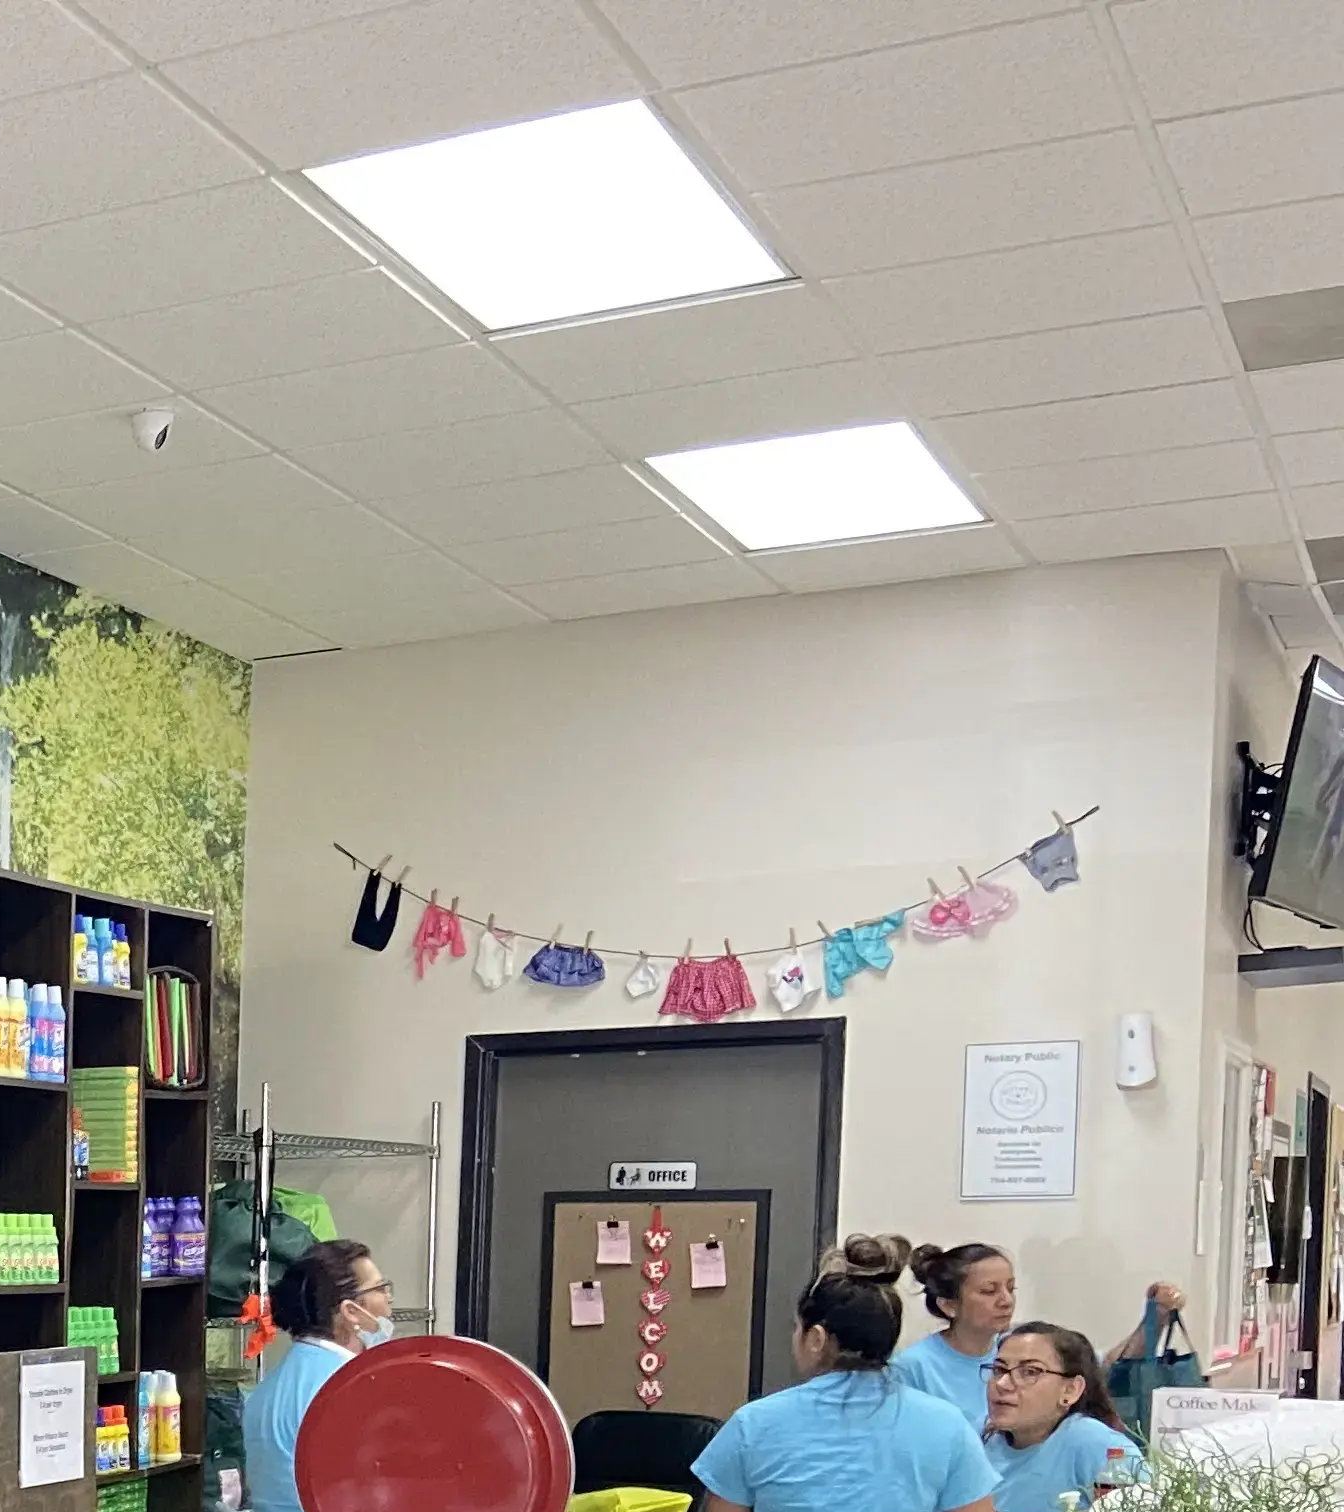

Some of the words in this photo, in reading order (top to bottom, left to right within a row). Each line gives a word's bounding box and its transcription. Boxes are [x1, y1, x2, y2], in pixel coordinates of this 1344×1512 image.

[984, 1054, 1021, 1063] Notary
[1025, 1052, 1061, 1061] Public
[648, 1169, 688, 1182] OFFICE
[1166, 1395, 1218, 1410] Coffee
[1221, 1397, 1261, 1411] Mak
